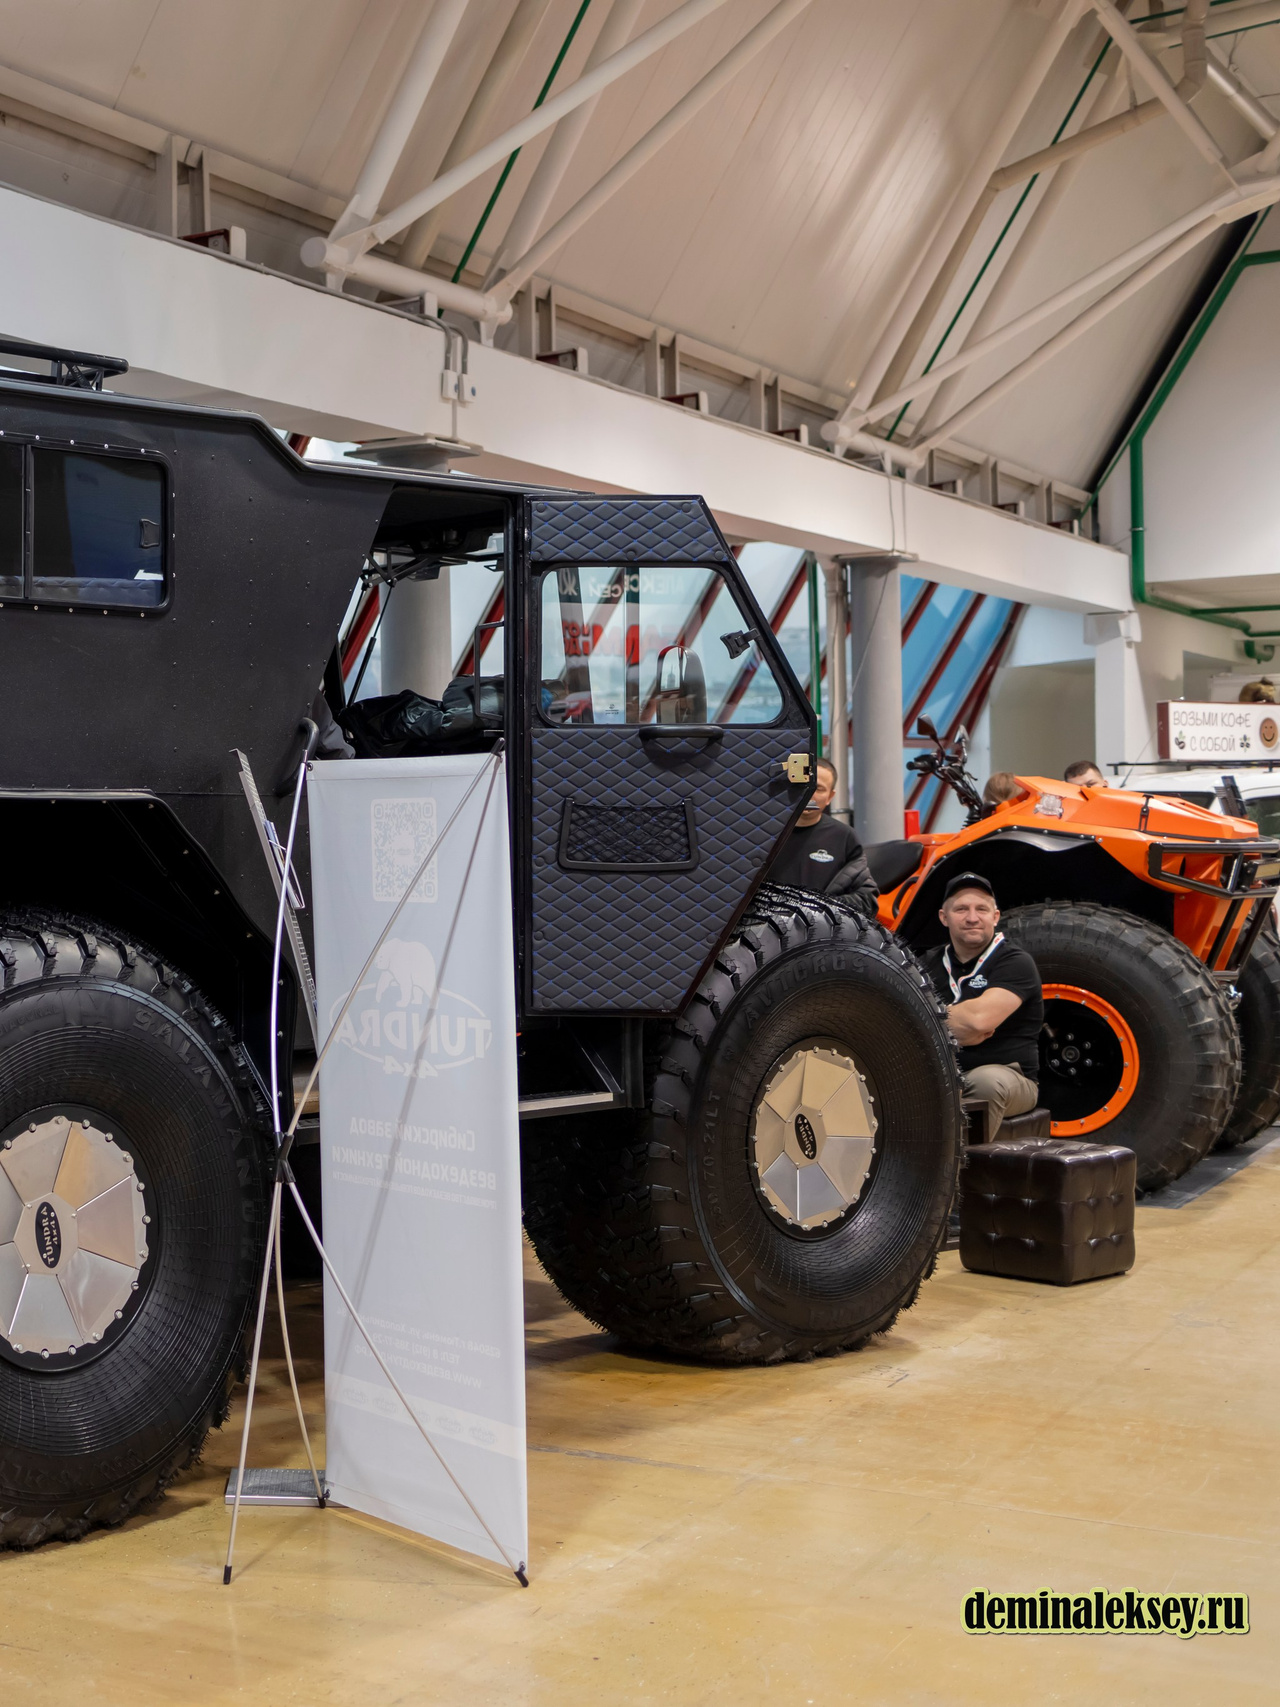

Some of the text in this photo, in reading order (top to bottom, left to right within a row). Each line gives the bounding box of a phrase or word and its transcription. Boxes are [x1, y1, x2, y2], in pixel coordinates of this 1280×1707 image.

[1173, 711, 1251, 728] ВОЗЬМИ КОФЕ
[1190, 735, 1235, 752] С СОБОЙ
[797, 1117, 814, 1157] TUNDRA
[41, 1206, 54, 1265] TUNDRA
